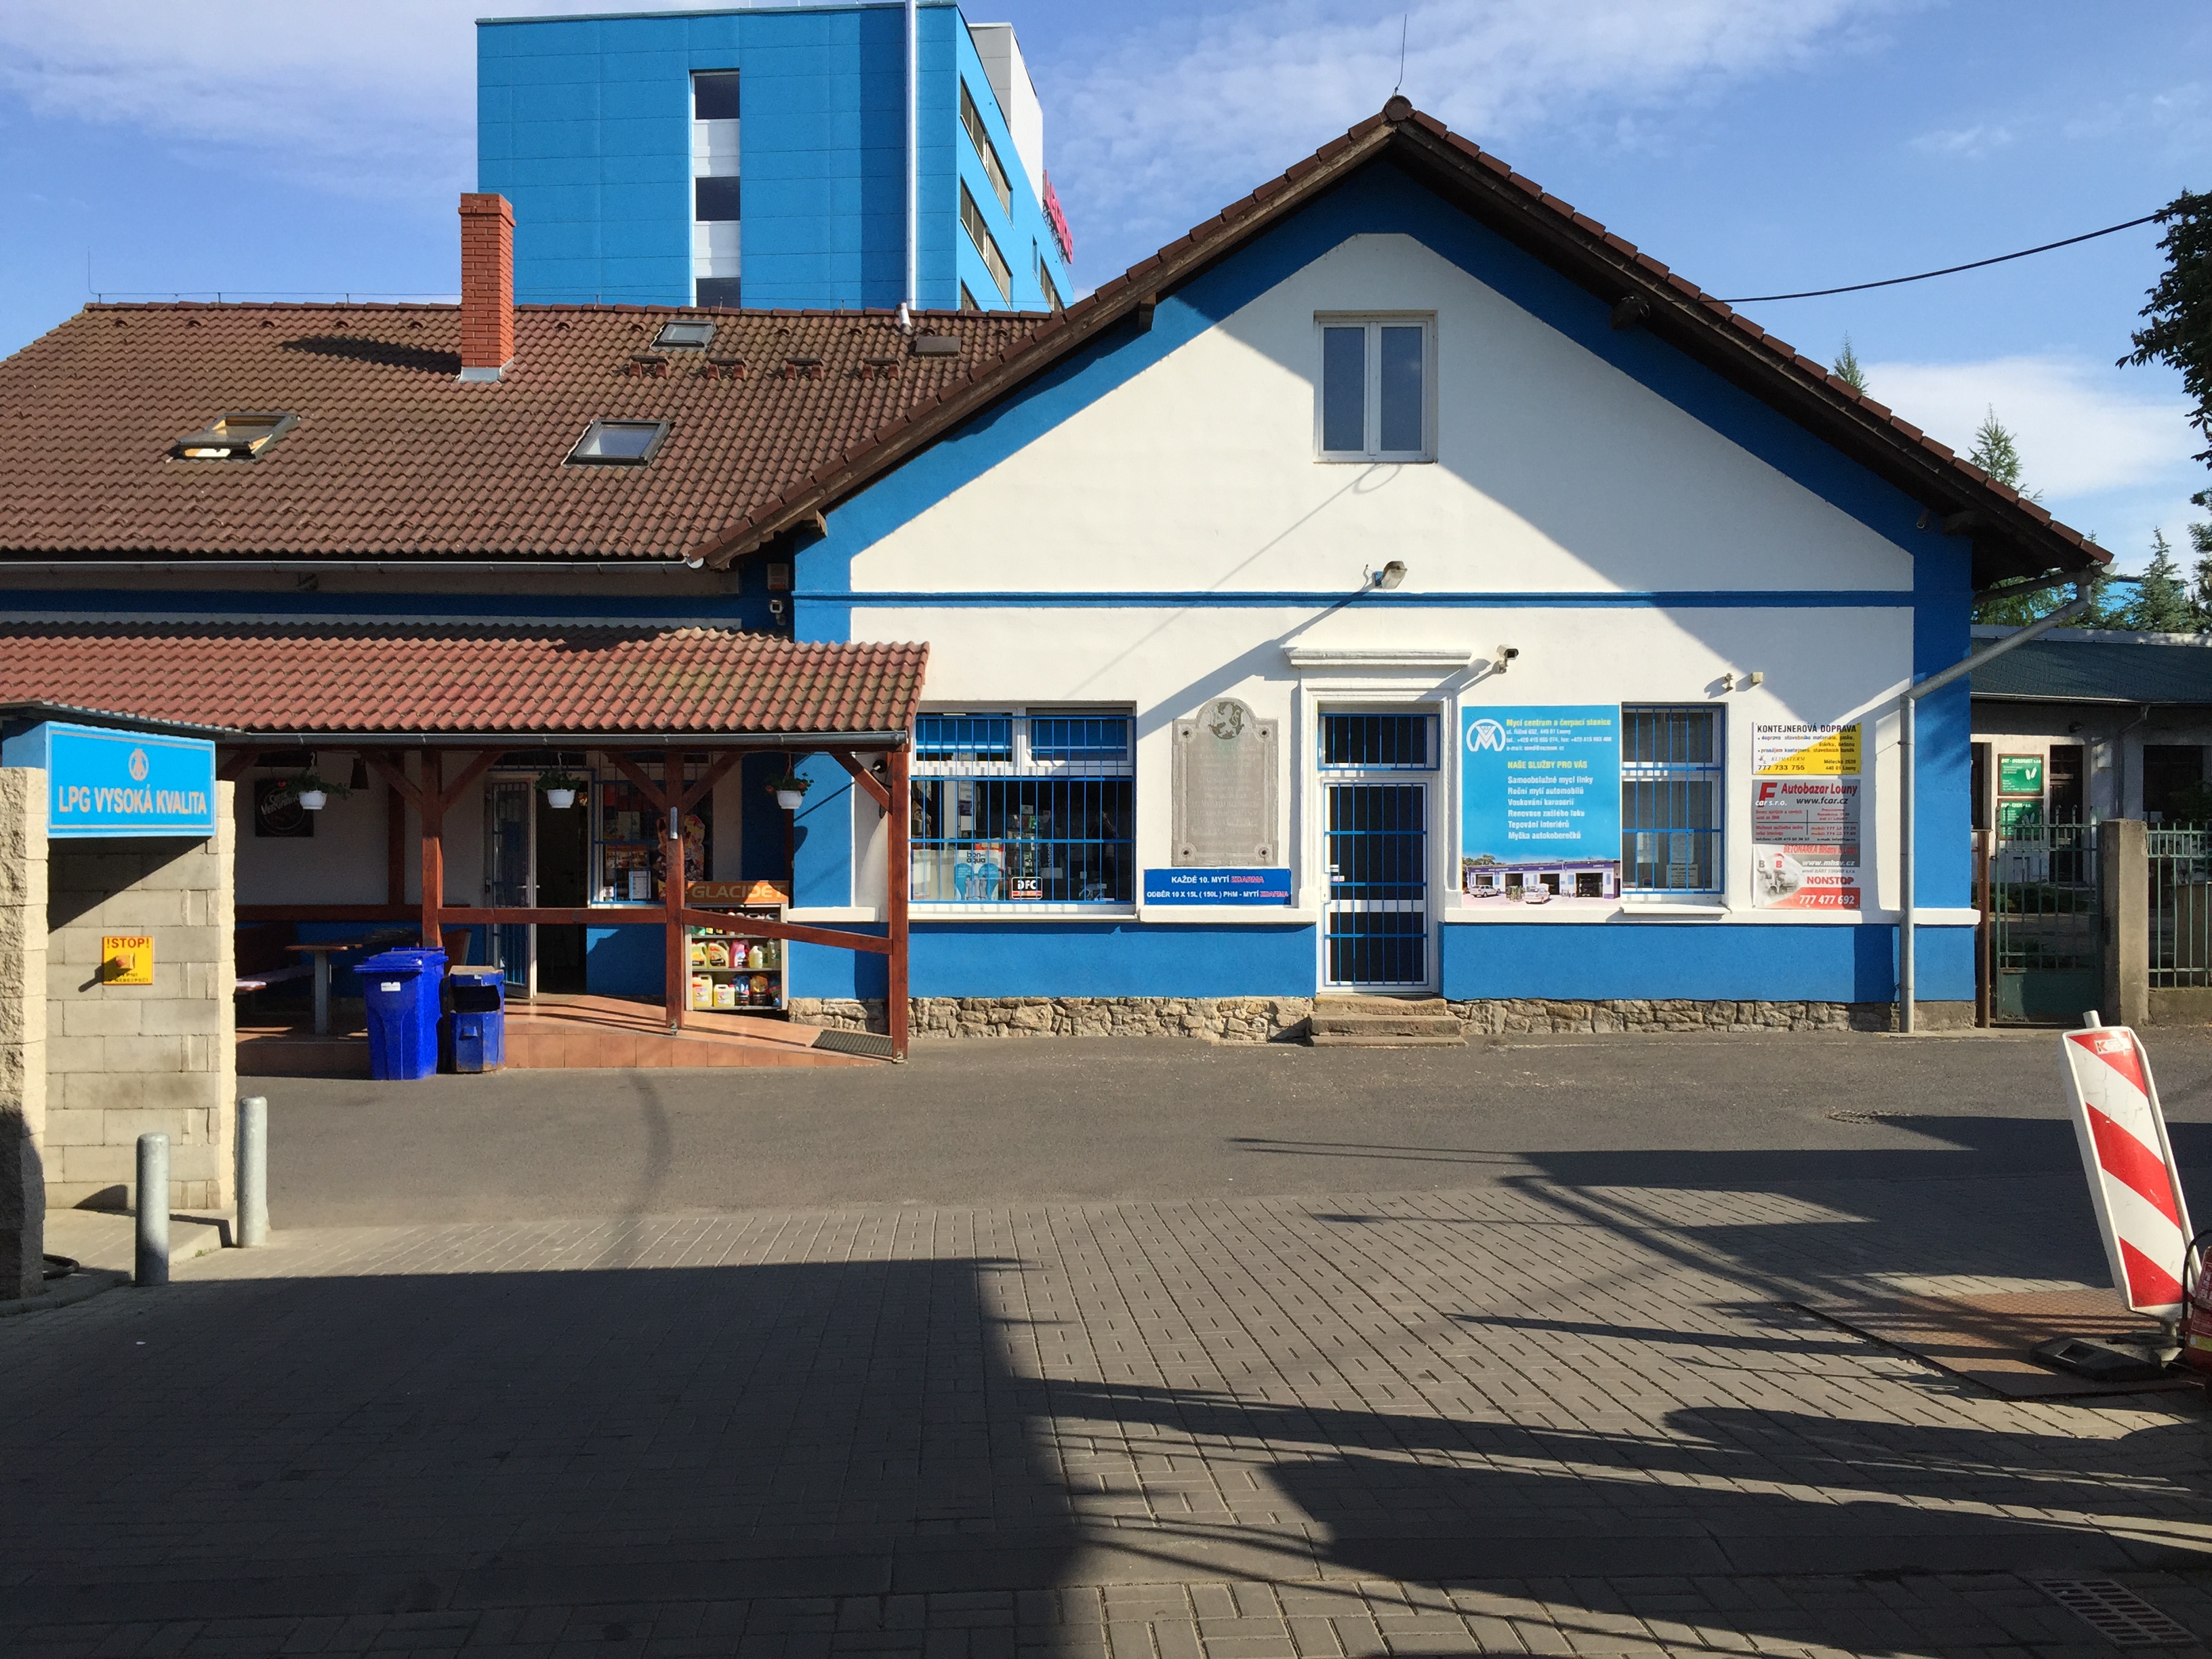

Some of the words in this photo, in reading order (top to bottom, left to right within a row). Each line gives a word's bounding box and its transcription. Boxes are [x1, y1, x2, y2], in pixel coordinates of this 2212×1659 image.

[1757, 723, 1817, 733] KONTEJNEROVÁ
[1820, 724, 1856, 733] DOPRAVA
[1507, 760, 1527, 769] NAŠE
[1528, 760, 1556, 769] SLUŽBY
[1557, 760, 1572, 769] PRO
[1574, 760, 1588, 769] VÁS
[1507, 776, 1557, 784] Samoobslužné
[1576, 776, 1594, 785] linky
[1545, 786, 1584, 794] automobilů
[1780, 783, 1829, 794] Autobazar
[1830, 783, 1858, 796] Louny
[58, 785, 91, 813] LPG
[94, 783, 153, 813] VYSOKÁ
[156, 789, 207, 815] KVALITA
[1507, 798, 1542, 806] Voskování
[1796, 796, 1849, 804] www.fcar.cz
[1507, 809, 1542, 817] Renovace
[1507, 820, 1539, 829] Tepování
[1508, 832, 1530, 840] Myčka
[1532, 831, 1581, 840] autokoberečků
[1171, 875, 1197, 884] KAŽDÉ
[1211, 875, 1229, 883] MYTÍ
[1807, 876, 1854, 885] NONSTOP
[692, 885, 785, 898] GLACIDET
[1799, 895, 1816, 905] 777
[1818, 895, 1836, 905] 477
[1837, 895, 1855, 905] 692
